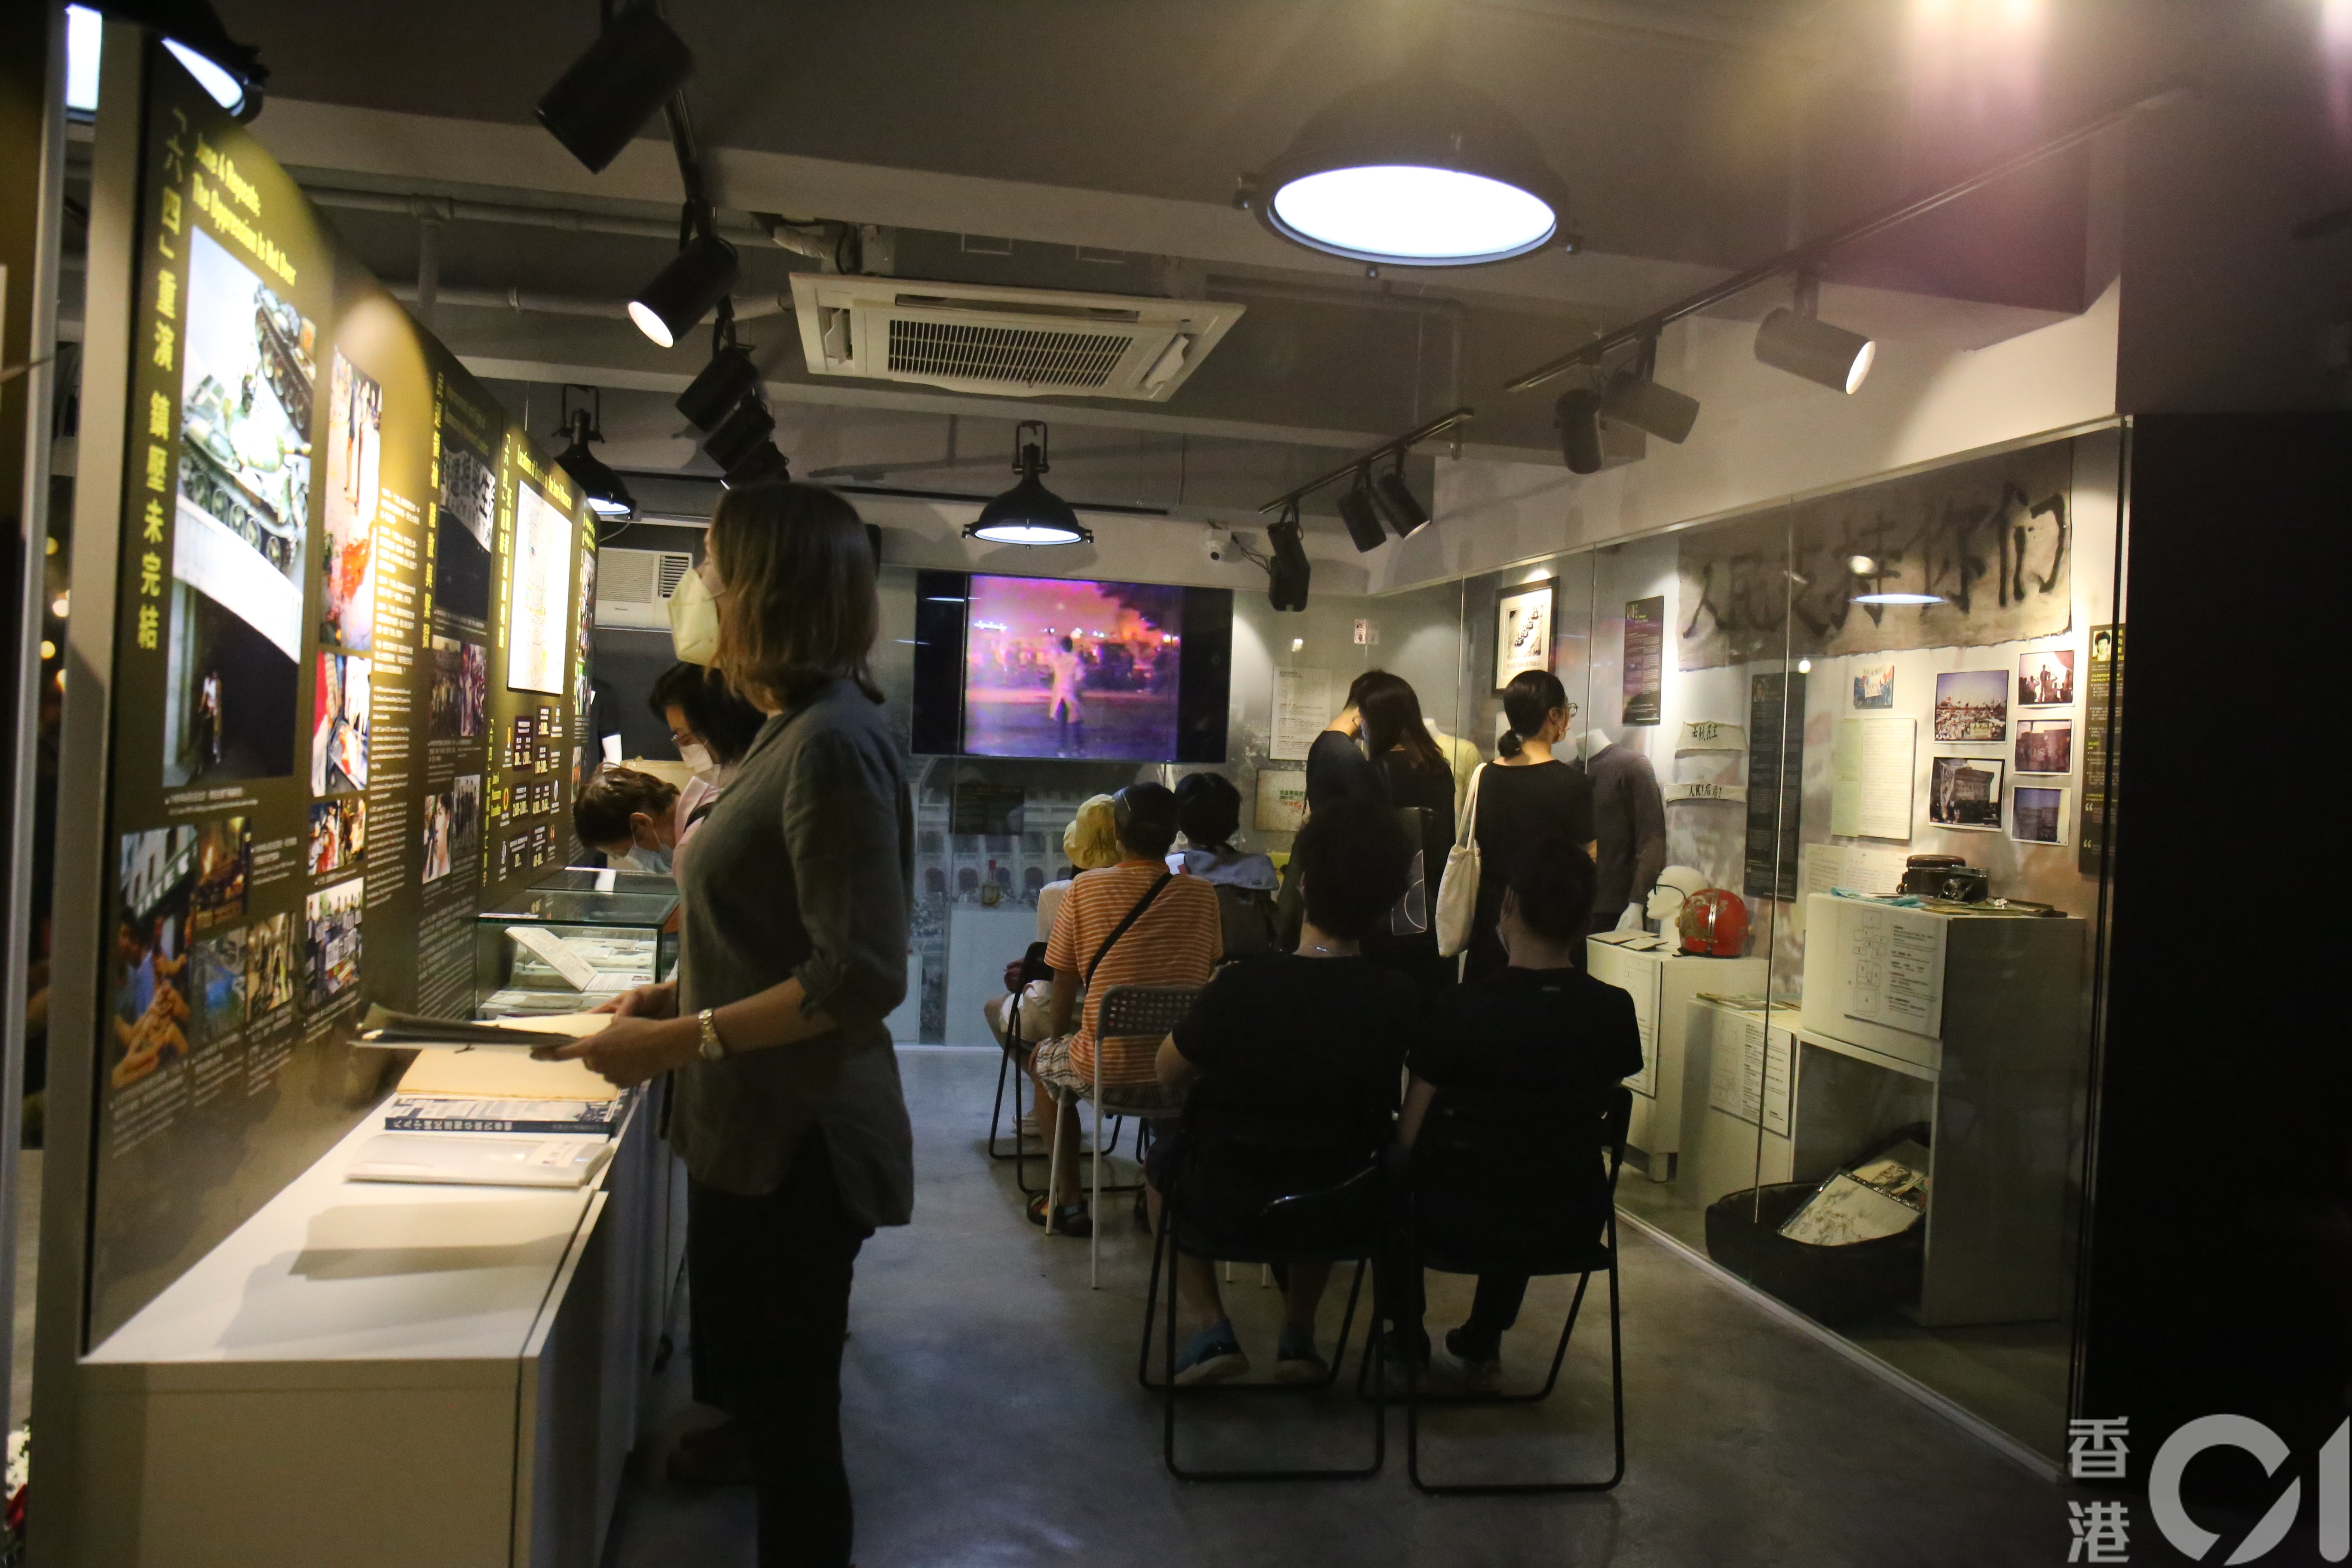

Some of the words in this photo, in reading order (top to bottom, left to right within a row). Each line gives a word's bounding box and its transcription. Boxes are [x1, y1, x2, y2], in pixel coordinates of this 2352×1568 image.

[138, 390, 171, 650] 鎮壓未完結
